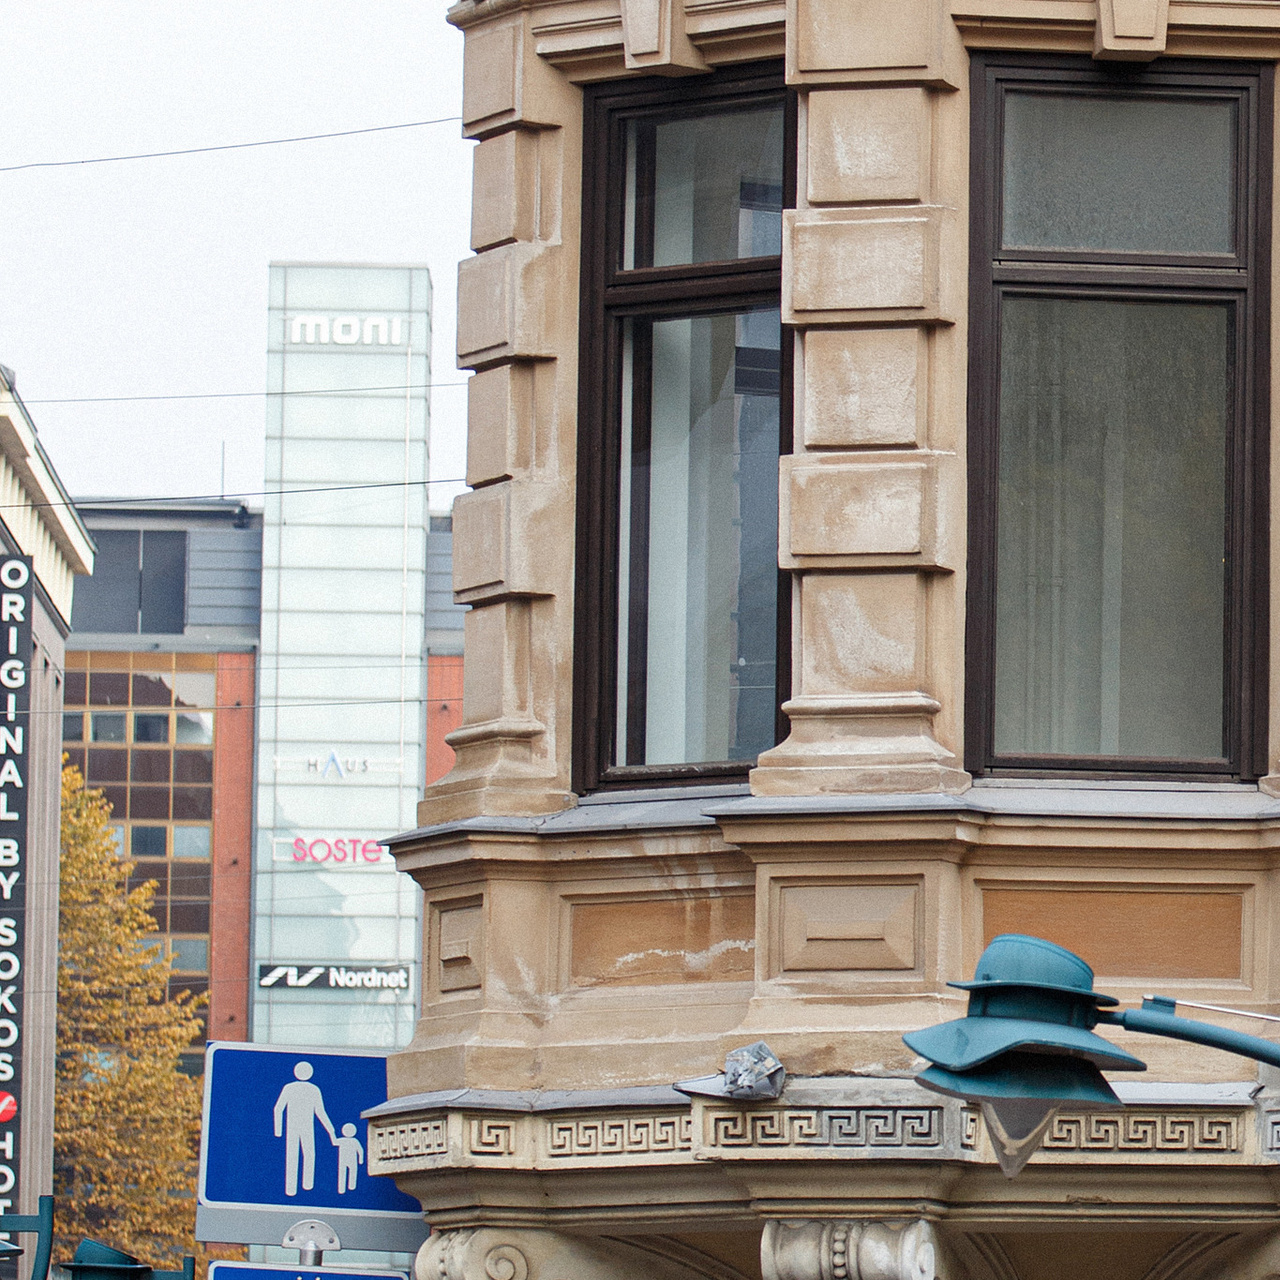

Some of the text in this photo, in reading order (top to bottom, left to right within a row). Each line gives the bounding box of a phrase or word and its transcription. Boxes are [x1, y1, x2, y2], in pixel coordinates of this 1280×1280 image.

[0, 559, 30, 821] ORIGINAL
[0, 837, 21, 900] BY
[329, 966, 408, 988] Nordnet
